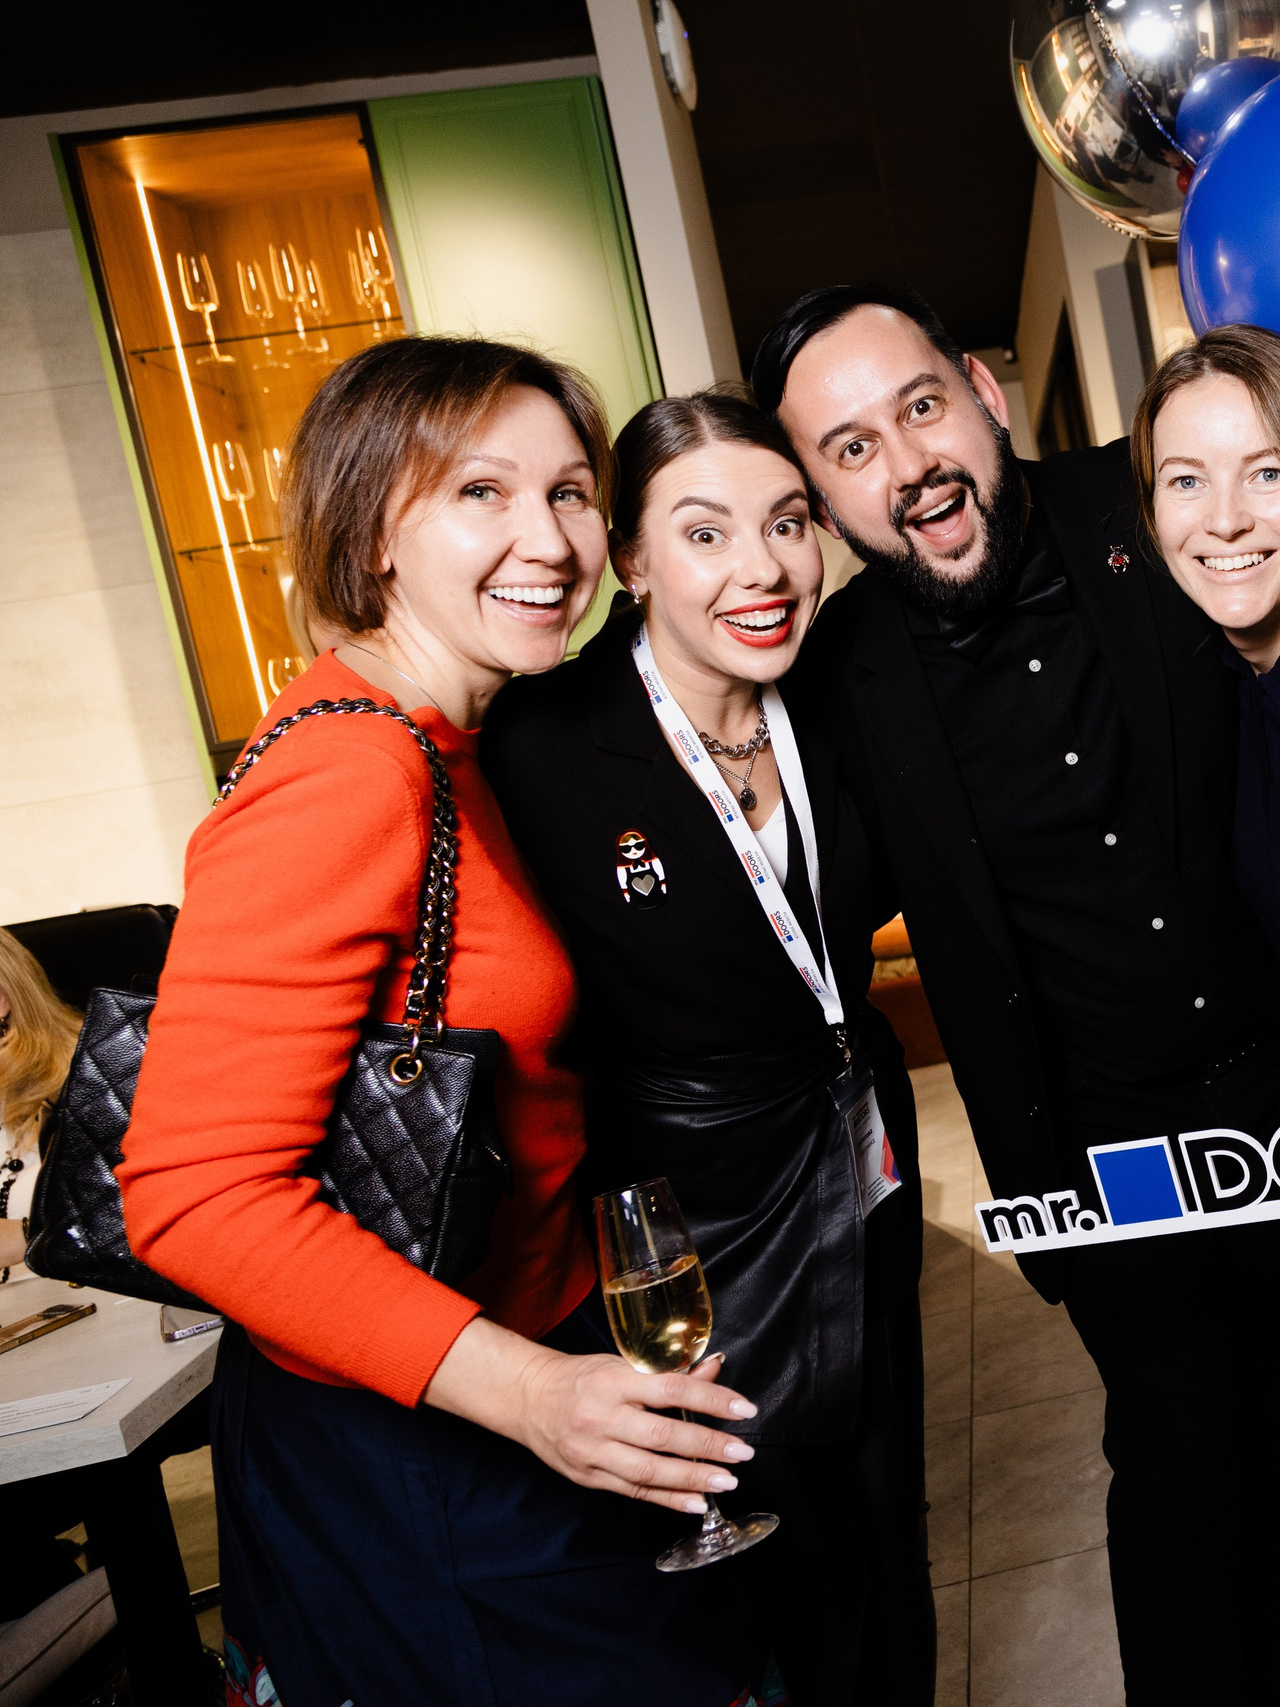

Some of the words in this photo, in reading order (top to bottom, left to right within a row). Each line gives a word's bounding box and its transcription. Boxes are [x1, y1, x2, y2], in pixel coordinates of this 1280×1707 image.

[642, 670, 658, 696] DOORS
[677, 730, 695, 755] DOORS
[712, 789, 731, 815] DOORS
[745, 850, 762, 877] DOORS
[774, 911, 790, 936] DOORS
[978, 1196, 1096, 1244] mr.
